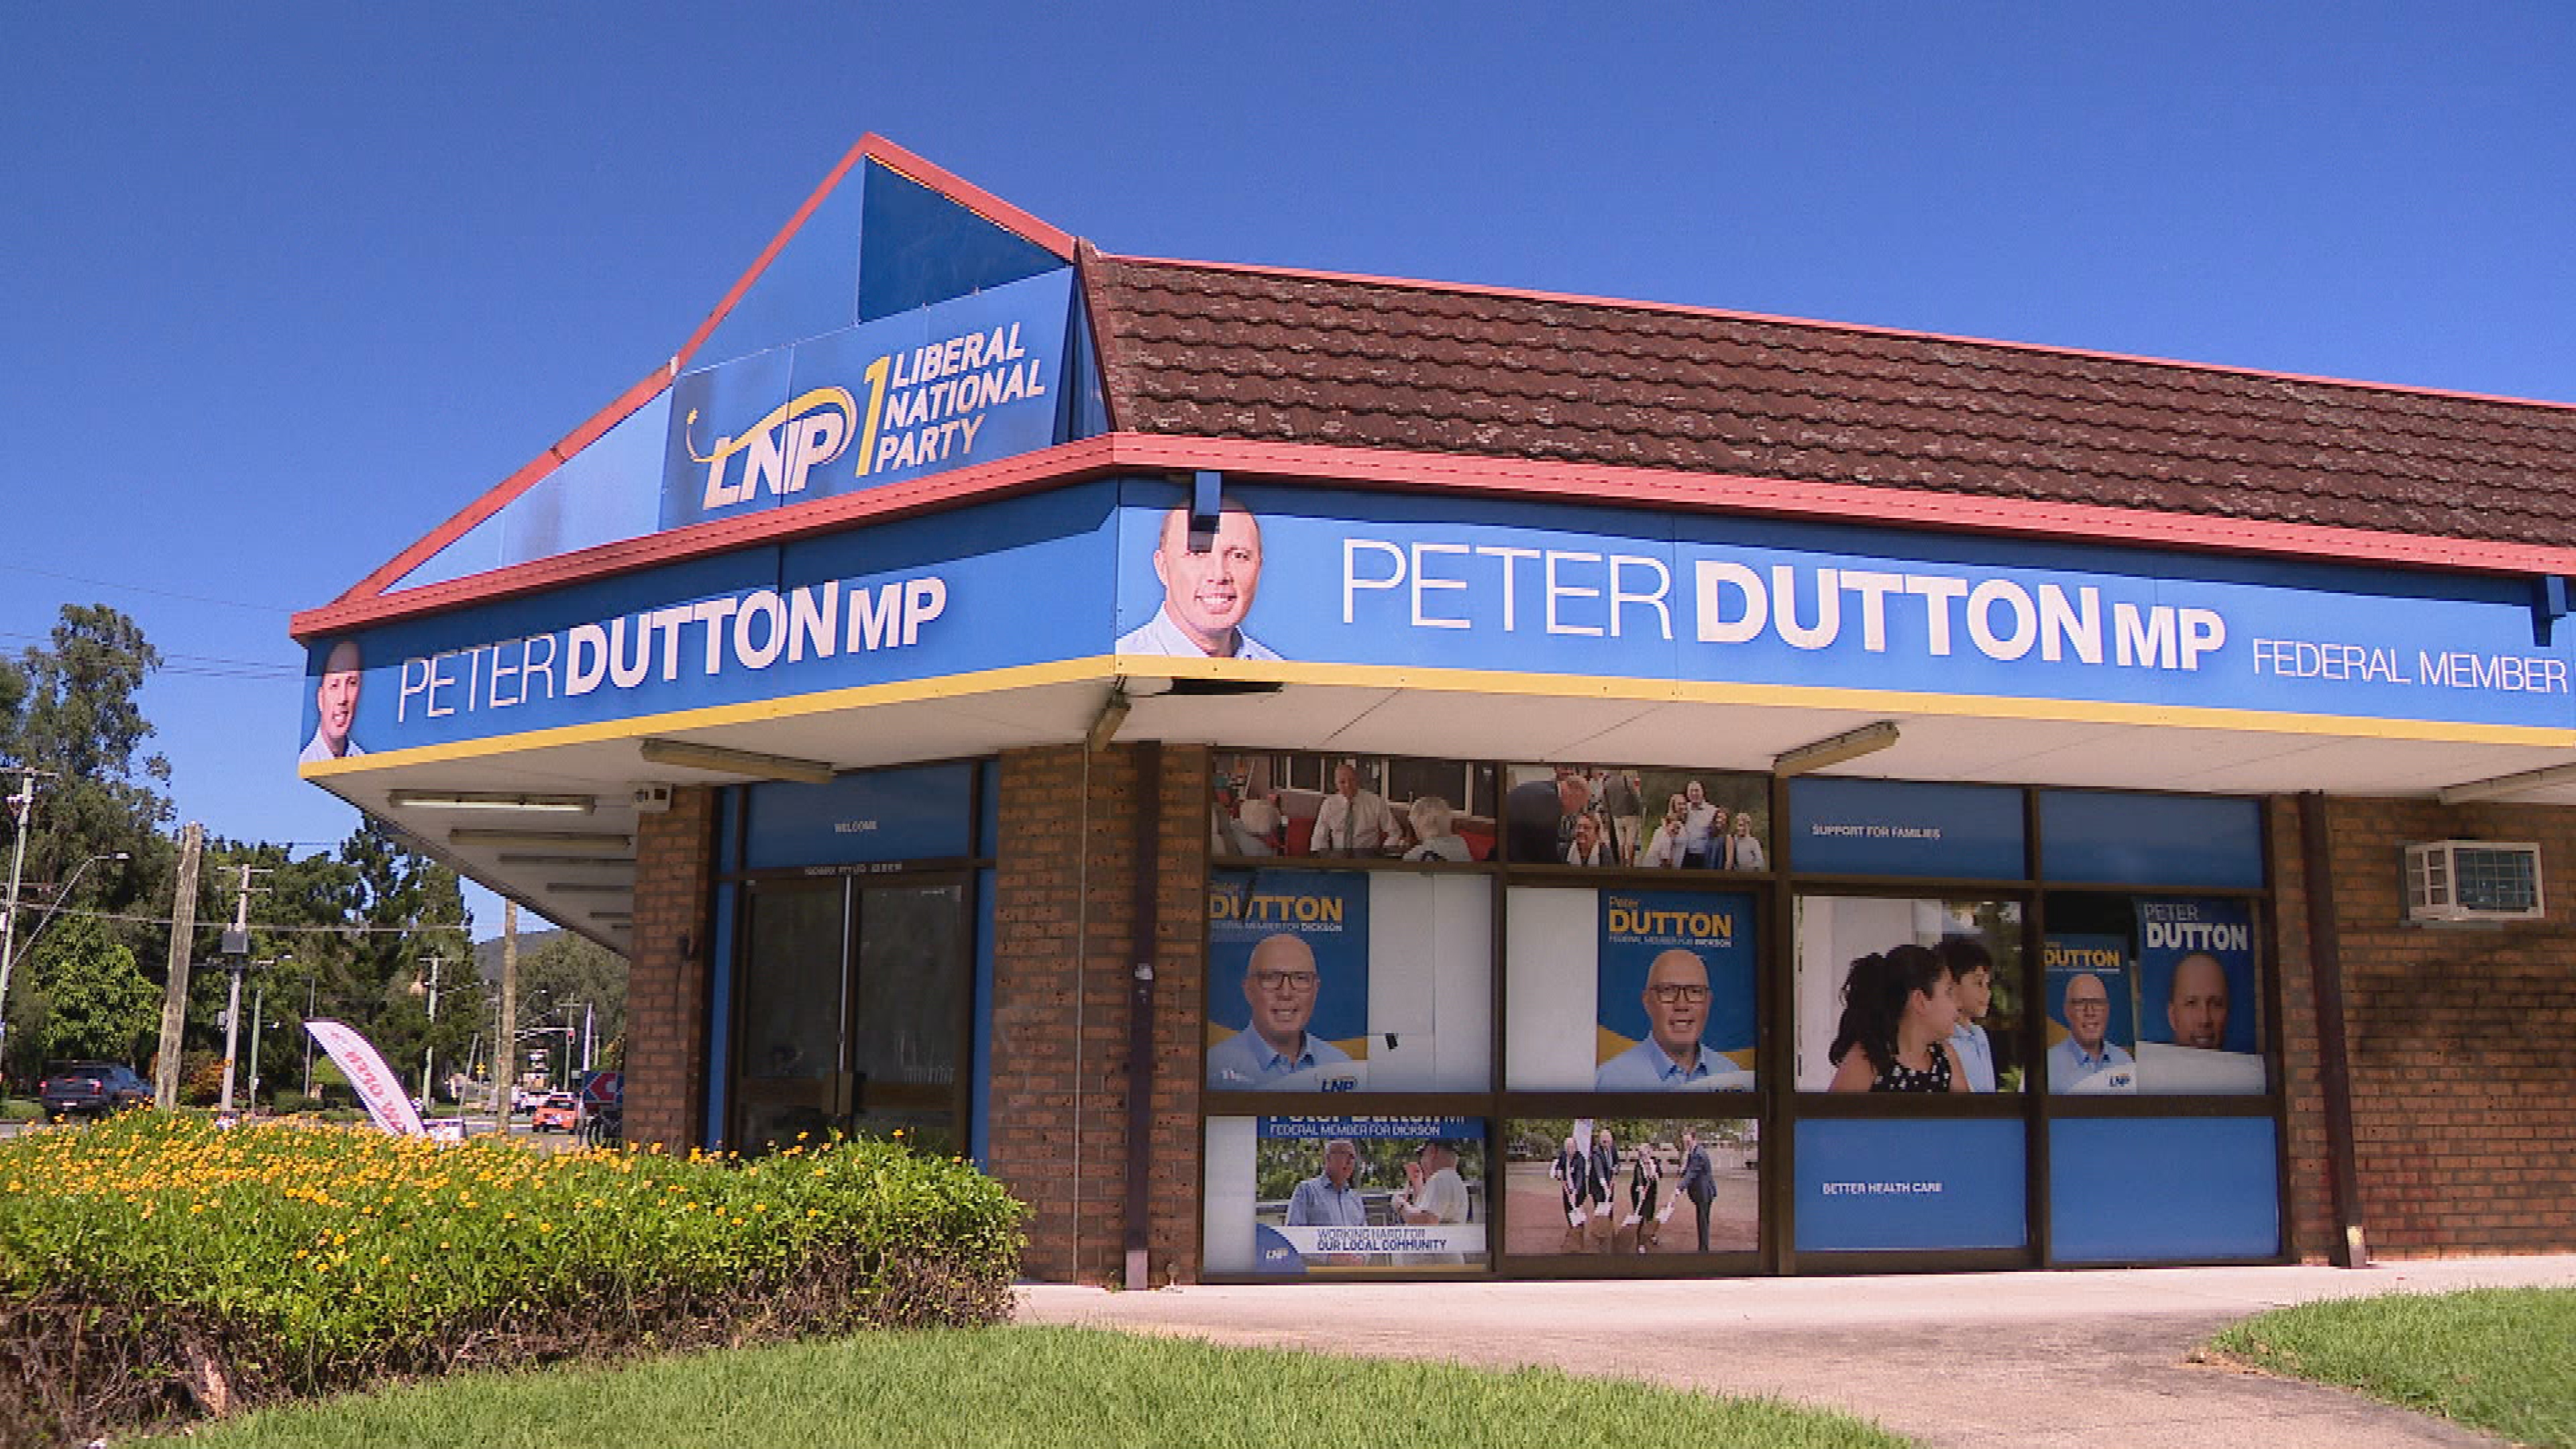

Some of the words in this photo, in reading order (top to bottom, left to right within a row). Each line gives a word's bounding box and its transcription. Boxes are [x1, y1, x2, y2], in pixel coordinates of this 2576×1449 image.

[892, 321, 1026, 388] LIBERAL
[883, 359, 1046, 430] NATIONAL
[875, 414, 987, 474] PARTY
[704, 411, 845, 511] LNP
[1343, 537, 1674, 640] PETER
[1695, 560, 2103, 663] DUTTON
[2116, 602, 2225, 672] MP
[2253, 638, 2412, 685] FEDERAL
[2419, 649, 2569, 694] MEMBER
[397, 634, 557, 723] PETER
[565, 580, 839, 697] DUTTON
[847, 577, 947, 655] MP
[834, 820, 877, 833] WELCOME
[1812, 824, 1864, 837] SUPPORT
[1866, 825, 1890, 838] FOR
[1892, 826, 1941, 841] FAMILIES
[1208, 895, 1342, 922] DUTTON
[2145, 904, 2200, 921] PETER
[1609, 909, 1732, 938] DUTTON
[2147, 922, 2247, 951] DUTTON
[2044, 949, 2120, 967] DUTTON
[1271, 1124, 1320, 1136] FEDERAL
[1320, 1124, 1367, 1136] MEMBER
[1368, 1124, 1391, 1136] FOR
[1392, 1124, 1440, 1136] DICKSON
[1823, 1183, 1866, 1195] BETTER
[1868, 1183, 1910, 1193] HEALTH
[1911, 1183, 1943, 1192] CARE
[1317, 1228, 1370, 1240] WORKING
[1371, 1228, 1401, 1240] HARD
[1403, 1228, 1426, 1240] FOR
[1317, 1240, 1341, 1251] OUR
[1342, 1240, 1380, 1251] LOCAL
[1382, 1239, 1447, 1251] COMMUNITY
